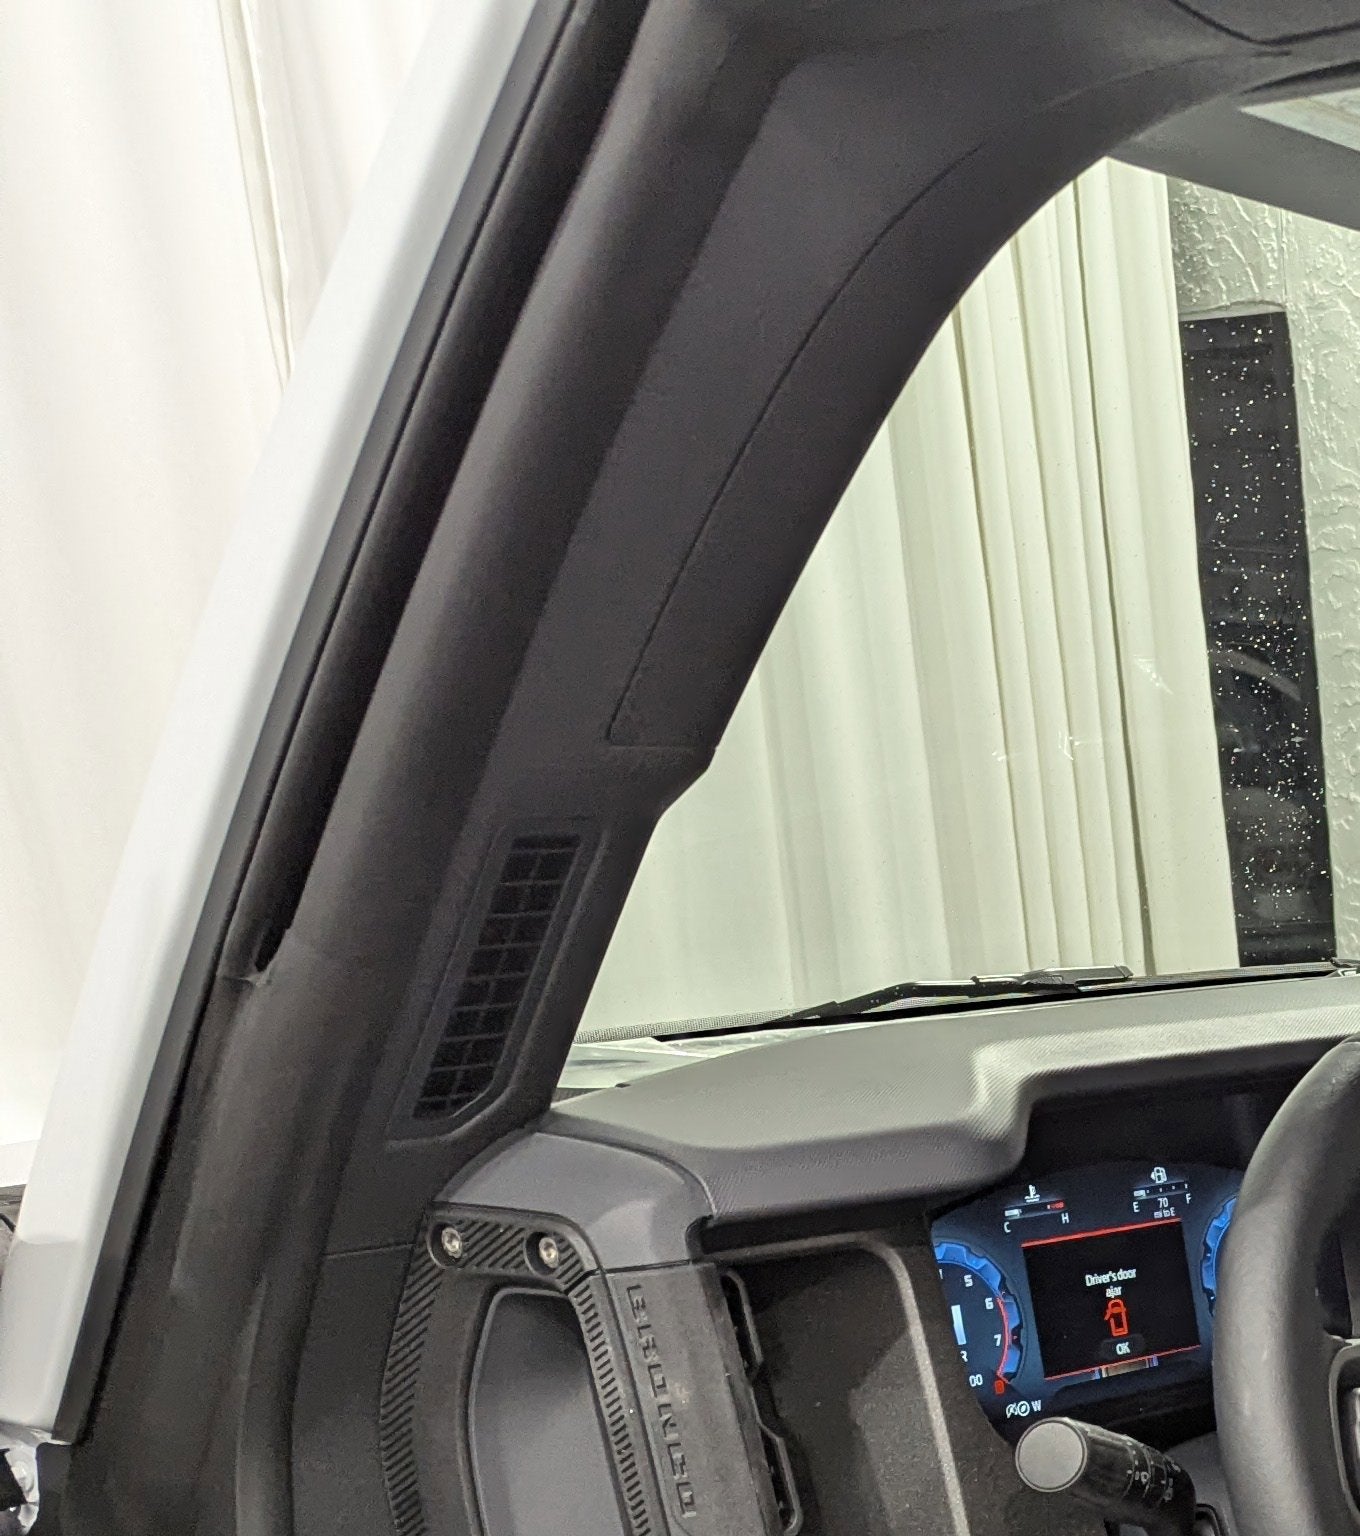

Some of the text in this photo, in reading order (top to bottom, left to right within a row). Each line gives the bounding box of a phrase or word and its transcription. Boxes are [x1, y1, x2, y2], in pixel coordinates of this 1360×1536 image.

[1132, 1193, 1192, 1213] E F
[1158, 1197, 1169, 1208] 70
[1003, 1212, 1070, 1233] C H
[964, 1275, 973, 1288] 5
[1085, 1267, 1137, 1287] Driver's door
[1105, 1285, 1122, 1298] ajar
[984, 1297, 994, 1310] 6
[993, 1334, 1002, 1347] 7
[1115, 1342, 1131, 1355] OK
[626, 1284, 697, 1518] BRONCO
